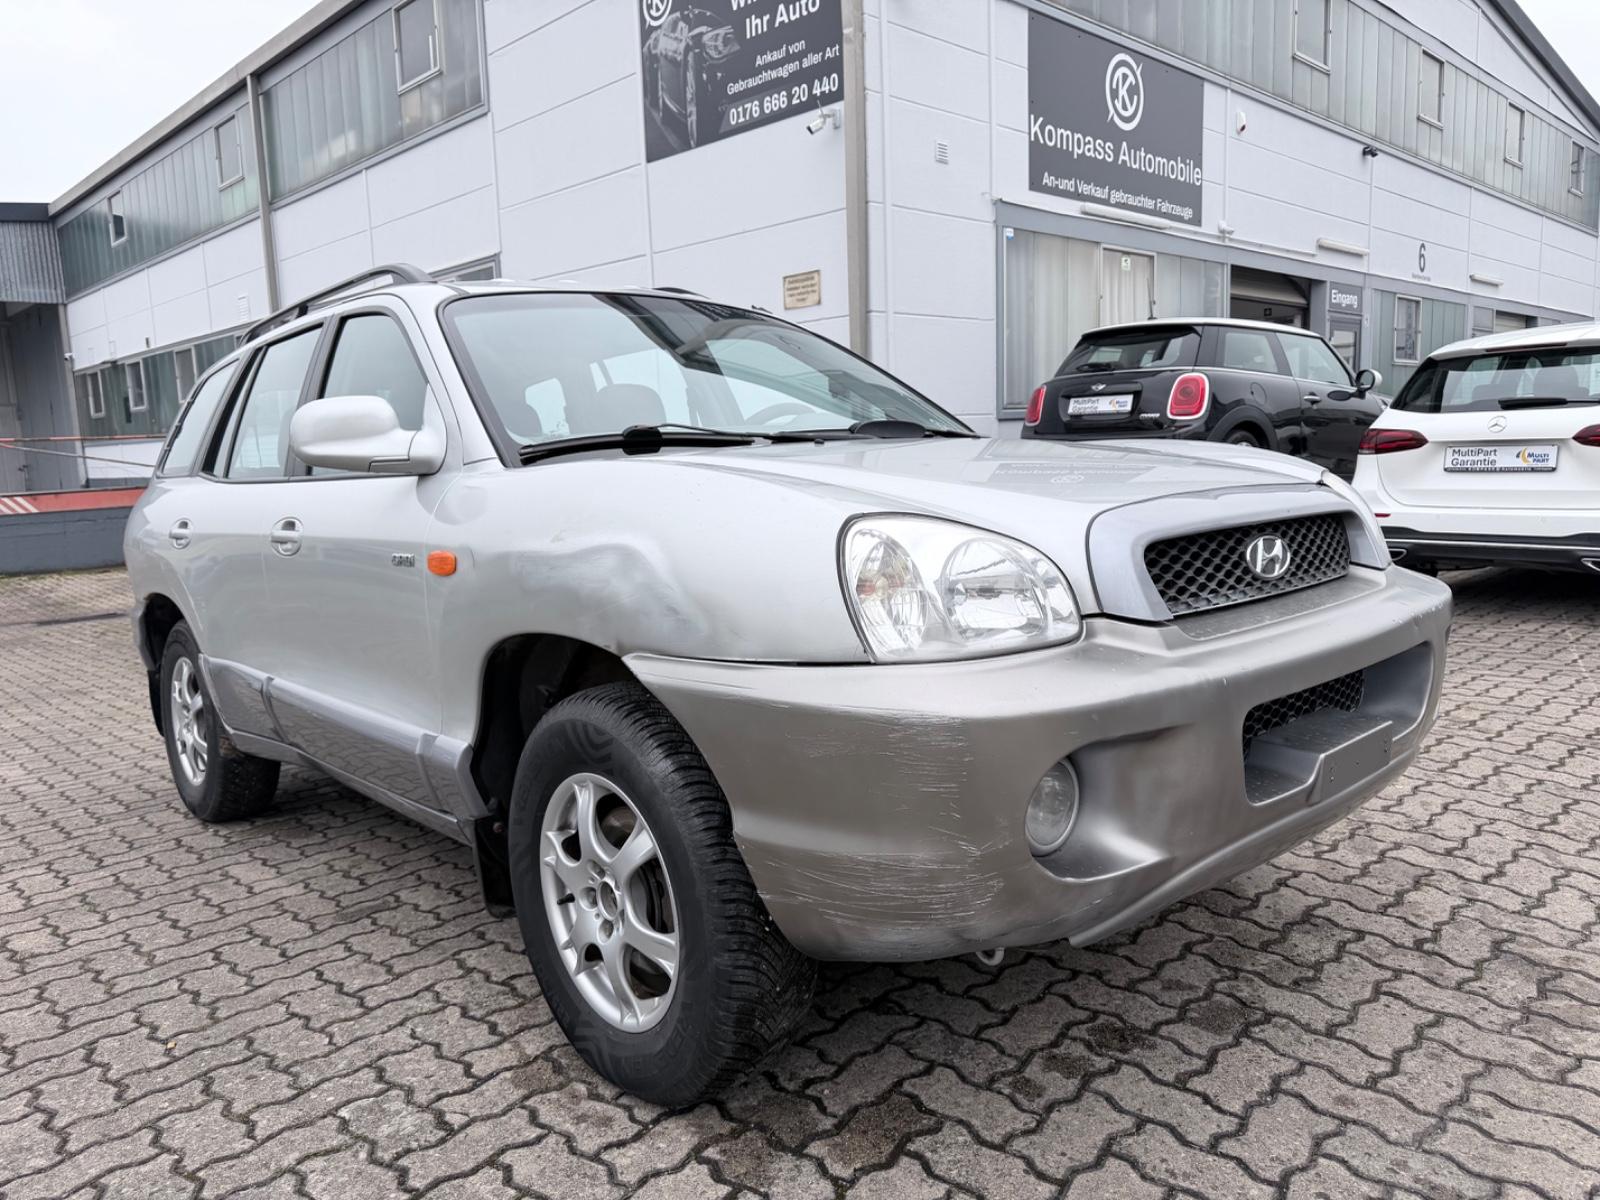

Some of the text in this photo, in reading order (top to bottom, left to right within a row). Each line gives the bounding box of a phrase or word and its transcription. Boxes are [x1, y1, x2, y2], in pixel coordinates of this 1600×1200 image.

[745, 14, 770, 39] Ihr
[774, 0, 820, 28] Auto
[727, 44, 840, 95] Gebrauchtwagen aller Art
[755, 40, 806, 68] Ankauf von
[729, 73, 839, 126] 0176 666 20 440
[1030, 114, 1202, 186] Kompass Automobile
[1042, 171, 1193, 220] An-und Verkauf gebrauchter Fahrzeuge
[1418, 242, 1426, 273] 6
[1331, 289, 1358, 308] Eingang
[1451, 457, 1497, 467] Garantie
[1452, 448, 1497, 457] MultiPart
